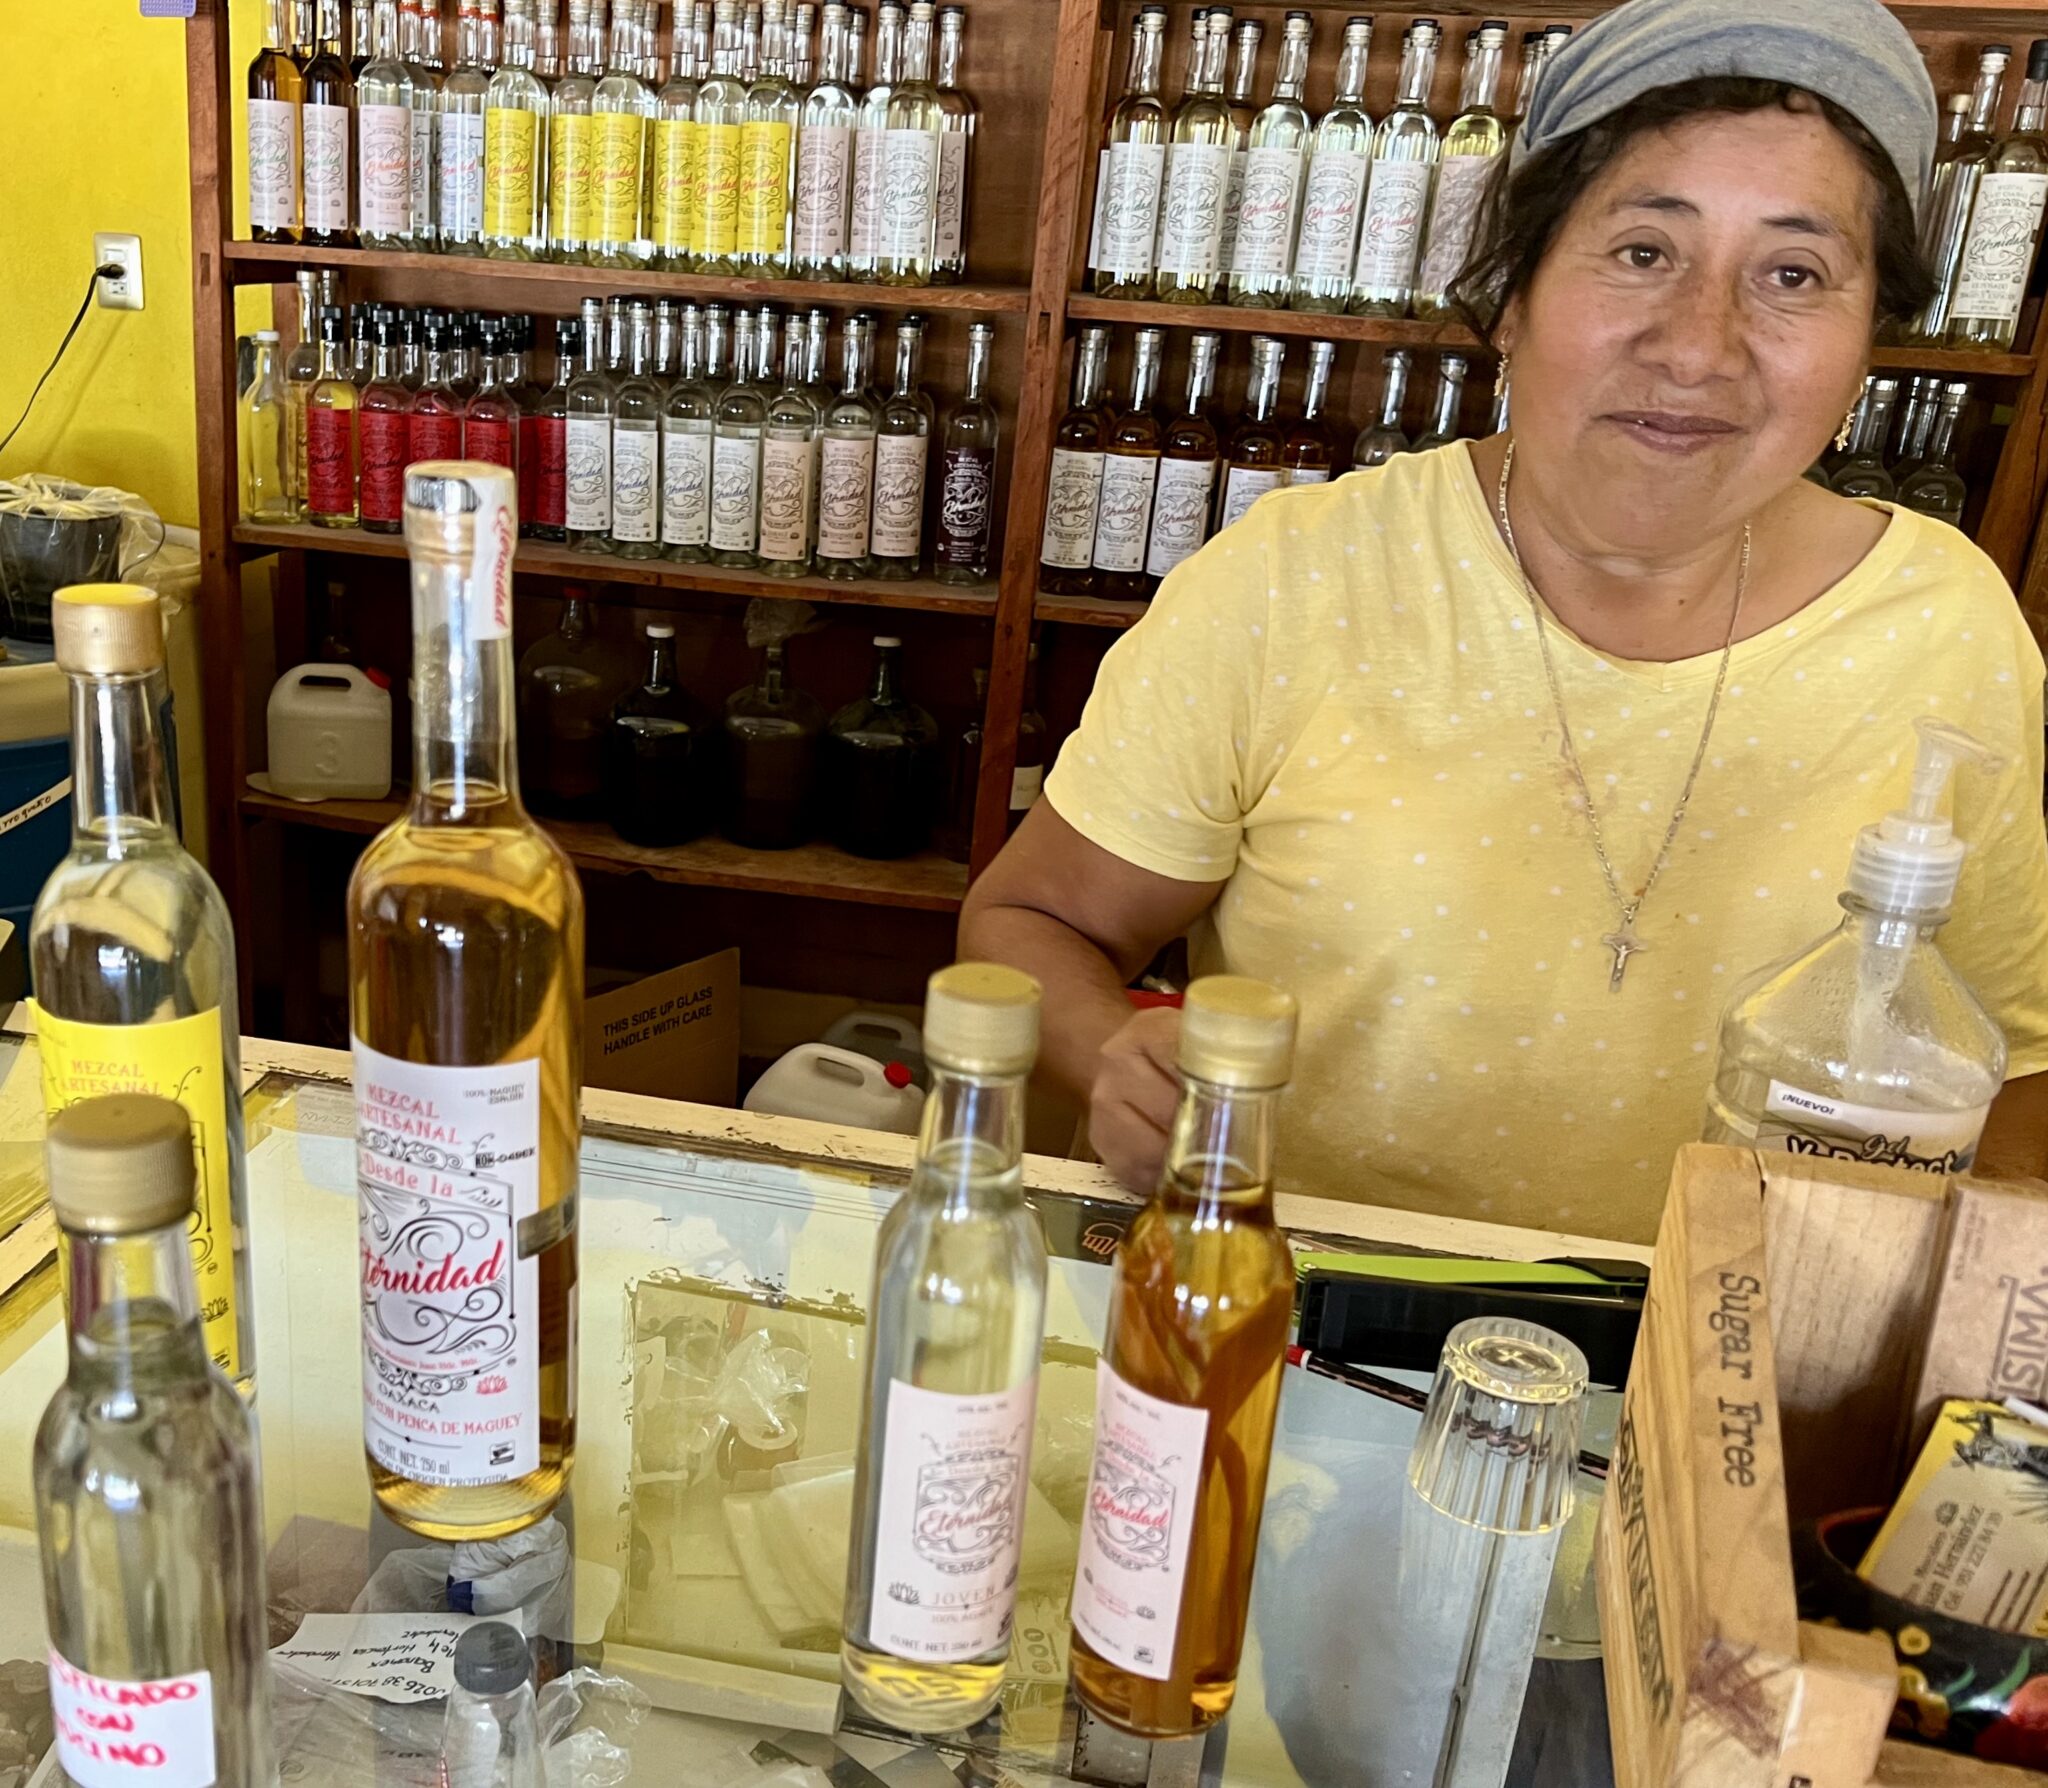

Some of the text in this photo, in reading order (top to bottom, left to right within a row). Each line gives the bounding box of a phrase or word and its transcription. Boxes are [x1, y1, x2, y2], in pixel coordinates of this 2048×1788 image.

[603, 986, 713, 1038] THIS SIDE UP GLASS
[603, 1004, 713, 1056] HANDLE WITH CARE
[69, 1059, 145, 1079] MEZCAL
[366, 1082, 441, 1120] MEZCAL
[1781, 1093, 1836, 1116] ¡NUEVO!
[362, 1151, 454, 1199] Desde la
[360, 1238, 506, 1298] ternidad
[378, 1382, 441, 1414] OAXACA
[1708, 1271, 1766, 1491] Sugar Free
[397, 1411, 438, 1434] PENCA
[441, 1421, 461, 1435] DE
[463, 1412, 524, 1436] MAGUEY
[933, 1587, 995, 1606] JOVEN
